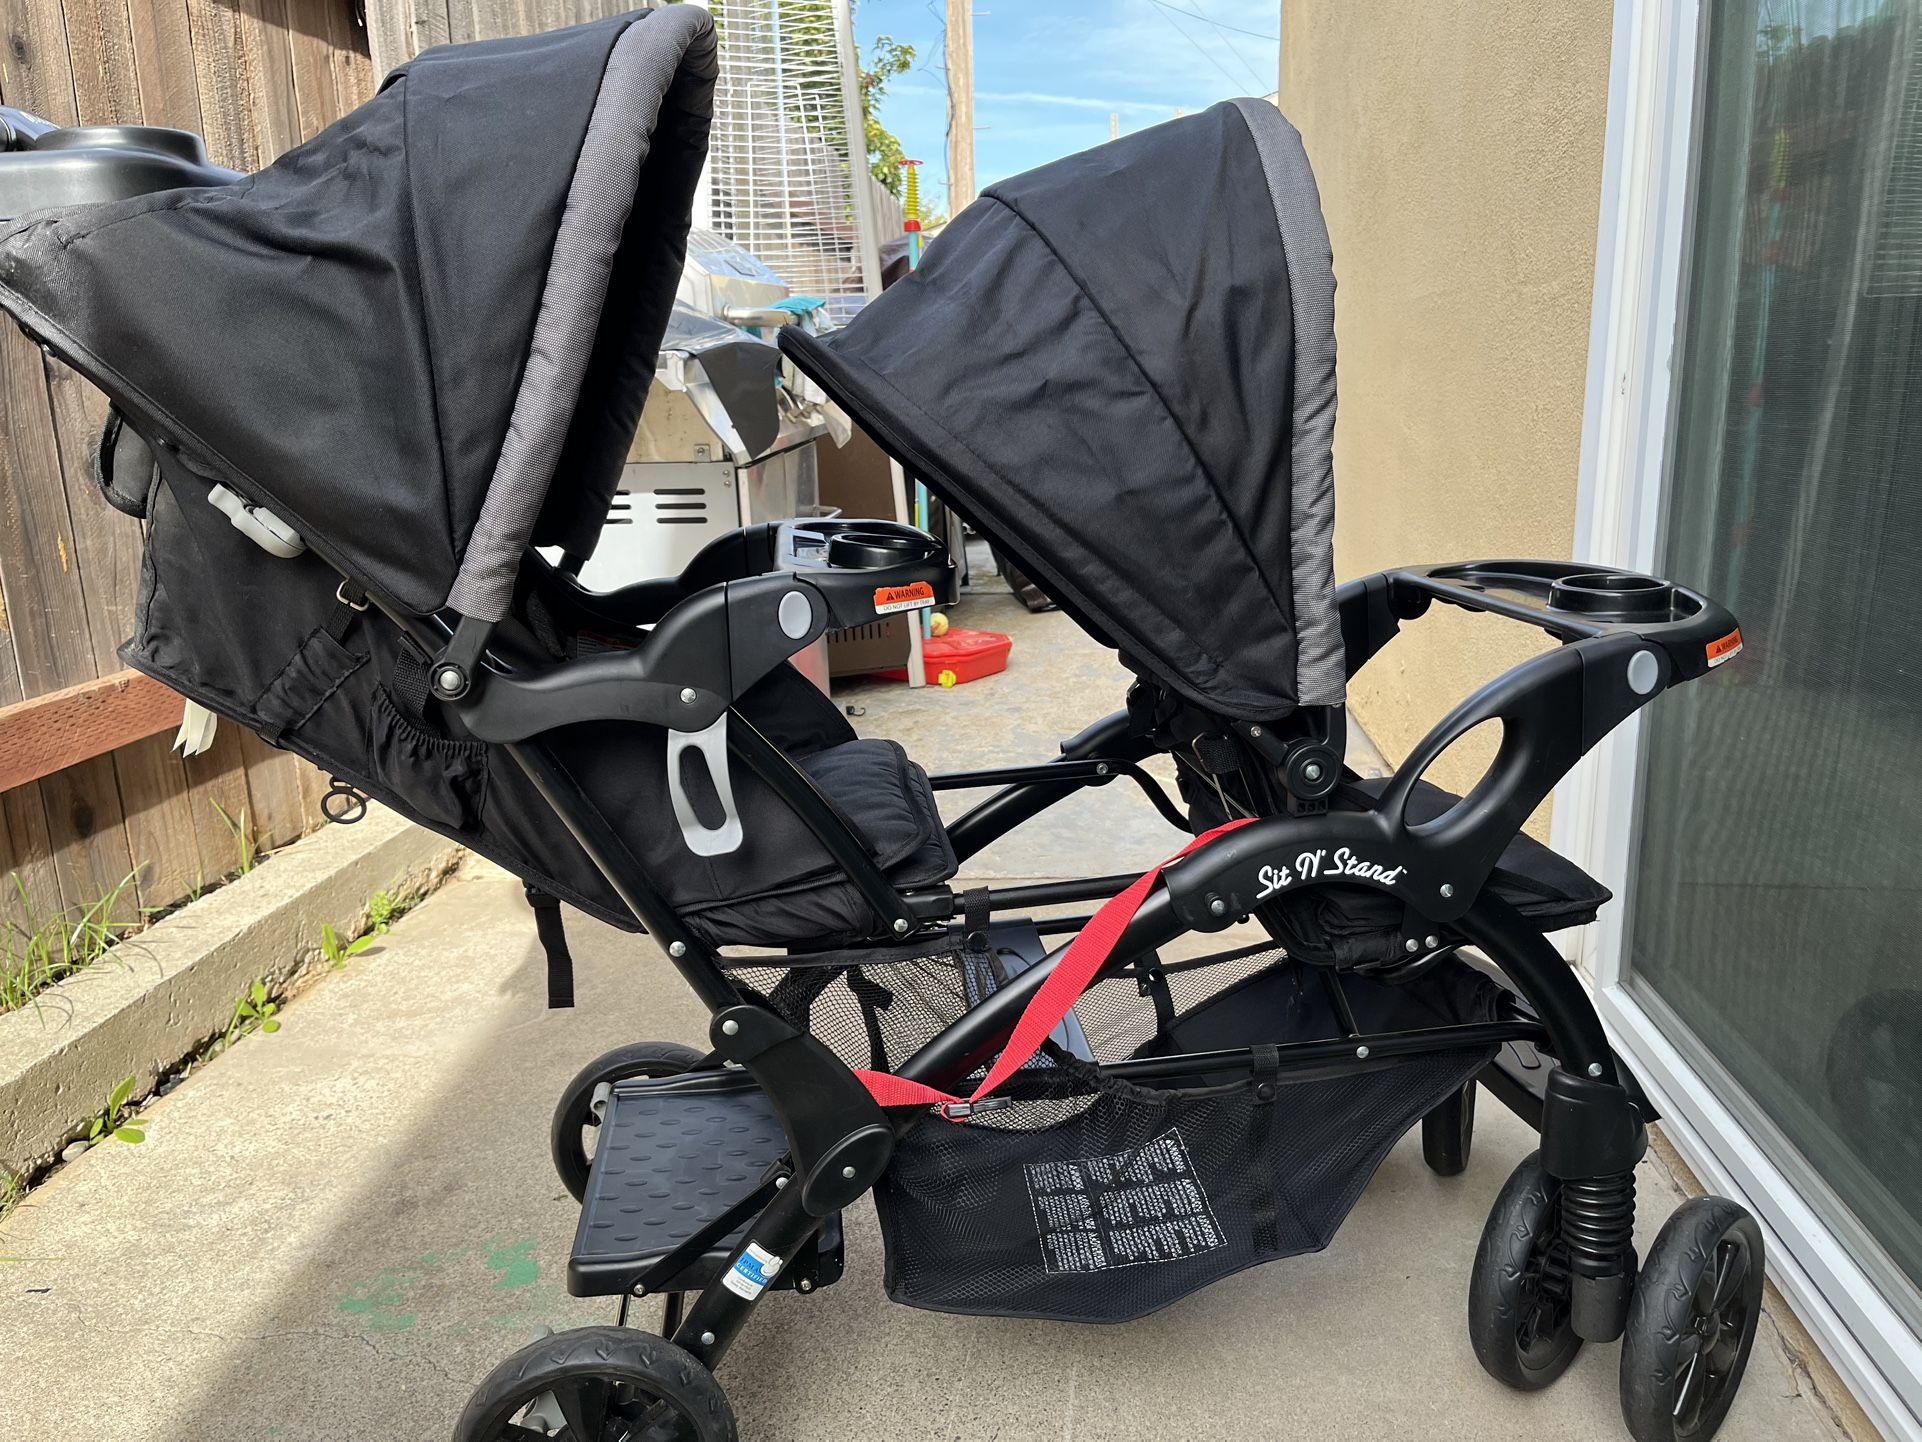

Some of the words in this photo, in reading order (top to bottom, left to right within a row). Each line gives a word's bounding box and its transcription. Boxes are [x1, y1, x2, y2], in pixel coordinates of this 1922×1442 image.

[894, 587, 925, 600] WARNING
[1256, 865, 1292, 899] Sit
[736, 1262, 768, 1284] CERTIFIED
